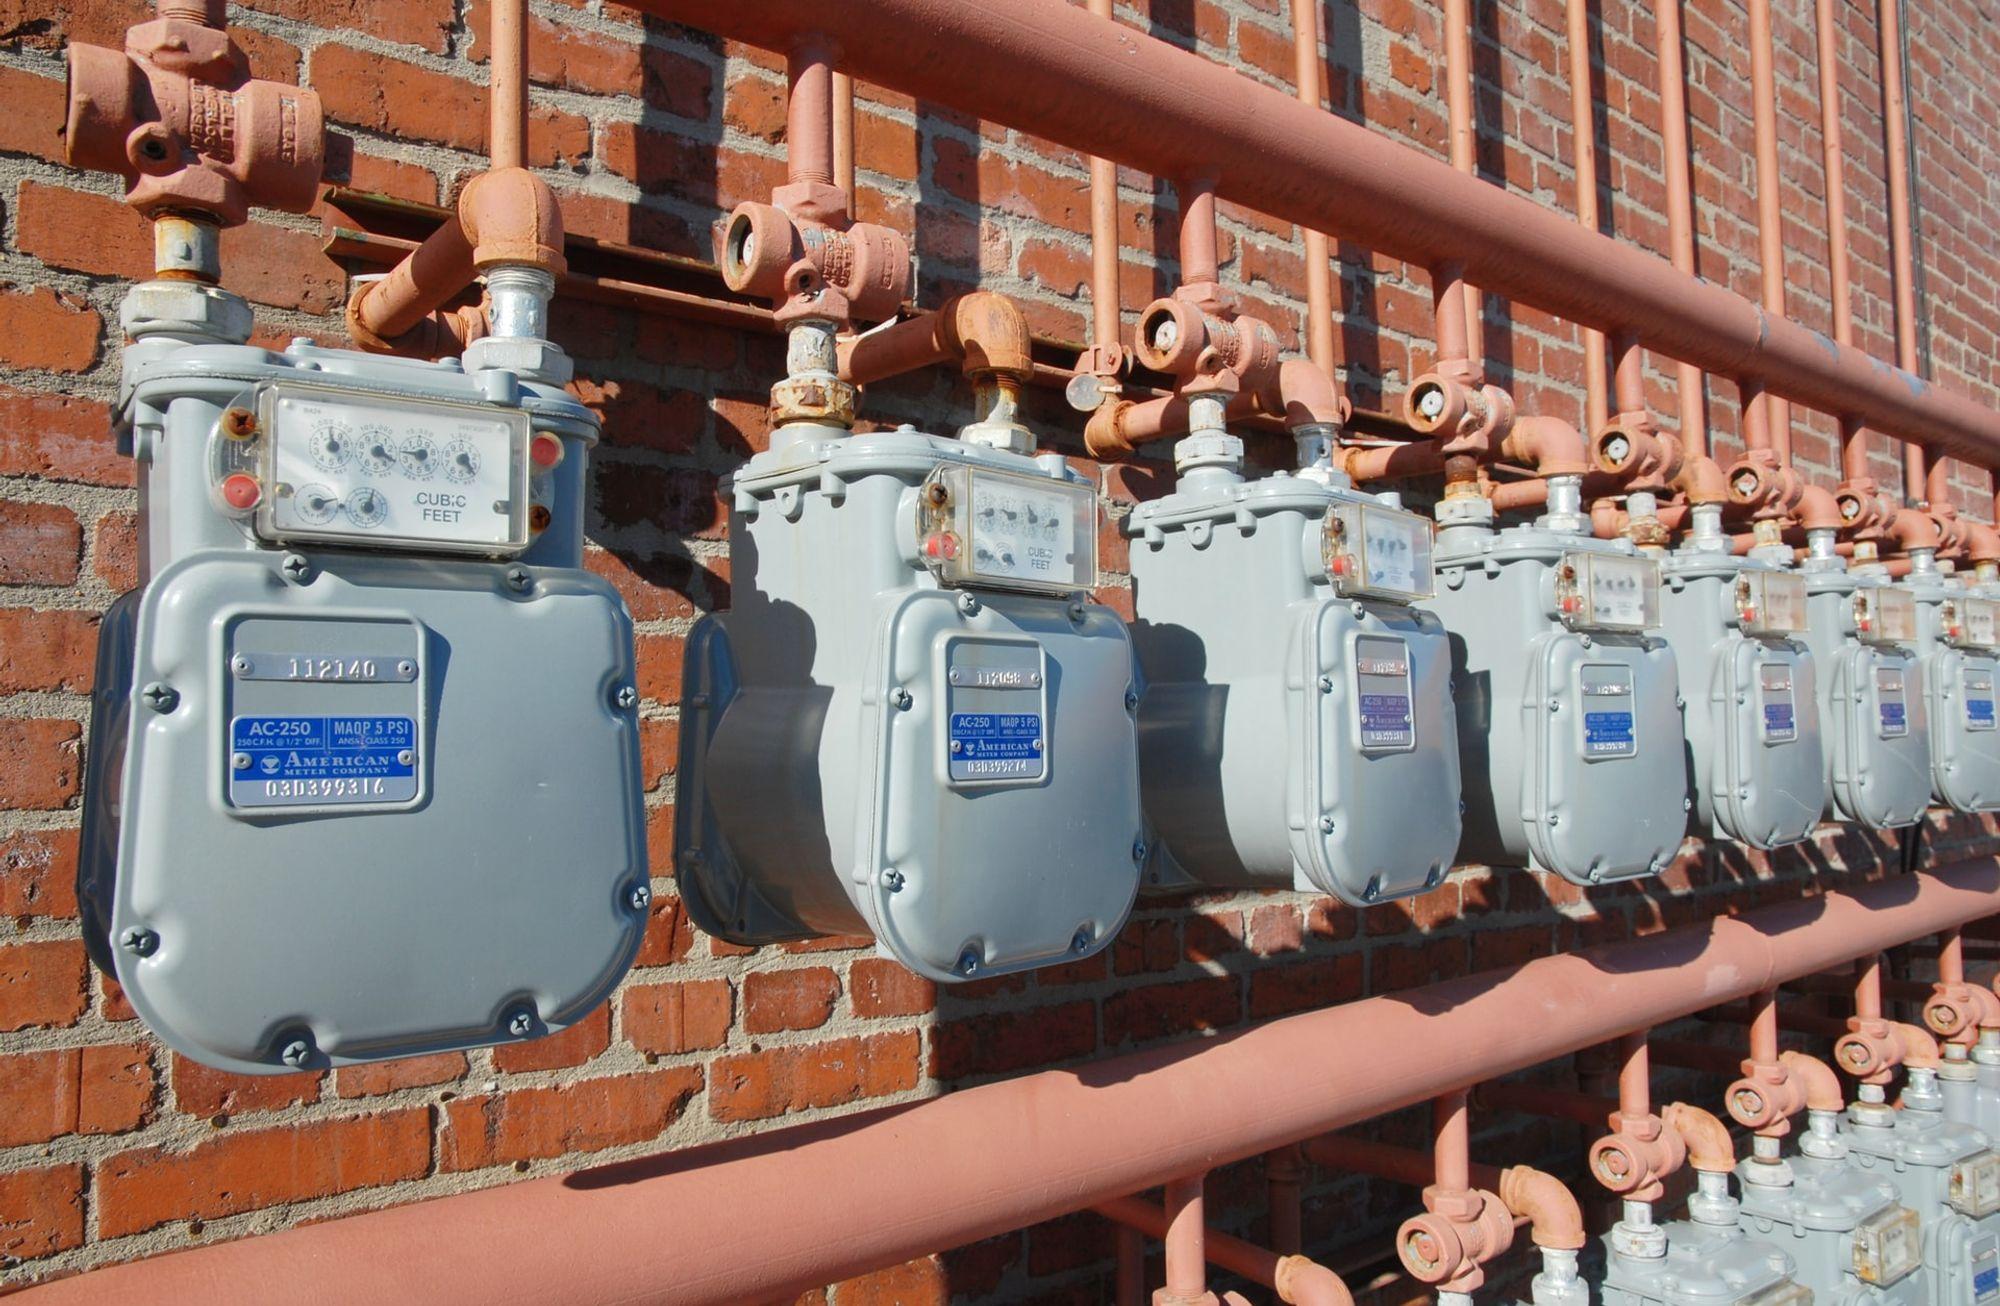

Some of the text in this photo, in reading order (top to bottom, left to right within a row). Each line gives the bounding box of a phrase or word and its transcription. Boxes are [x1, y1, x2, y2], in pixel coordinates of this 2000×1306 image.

[416, 492, 467, 507] CUBIC
[423, 509, 462, 523] FEET
[1031, 559, 1051, 571] FEET
[289, 658, 375, 679] 112140
[249, 721, 311, 736] AC-250
[334, 720, 409, 735] MAOP 5 PSI
[958, 717, 990, 728] AC-250
[1020, 717, 1026, 728] 5
[1026, 717, 1039, 728] PSI
[391, 736, 406, 745] 250
[977, 739, 1030, 751] AMERICAN
[284, 751, 389, 767] AMERICAN
[284, 767, 390, 776] METER COMPANY
